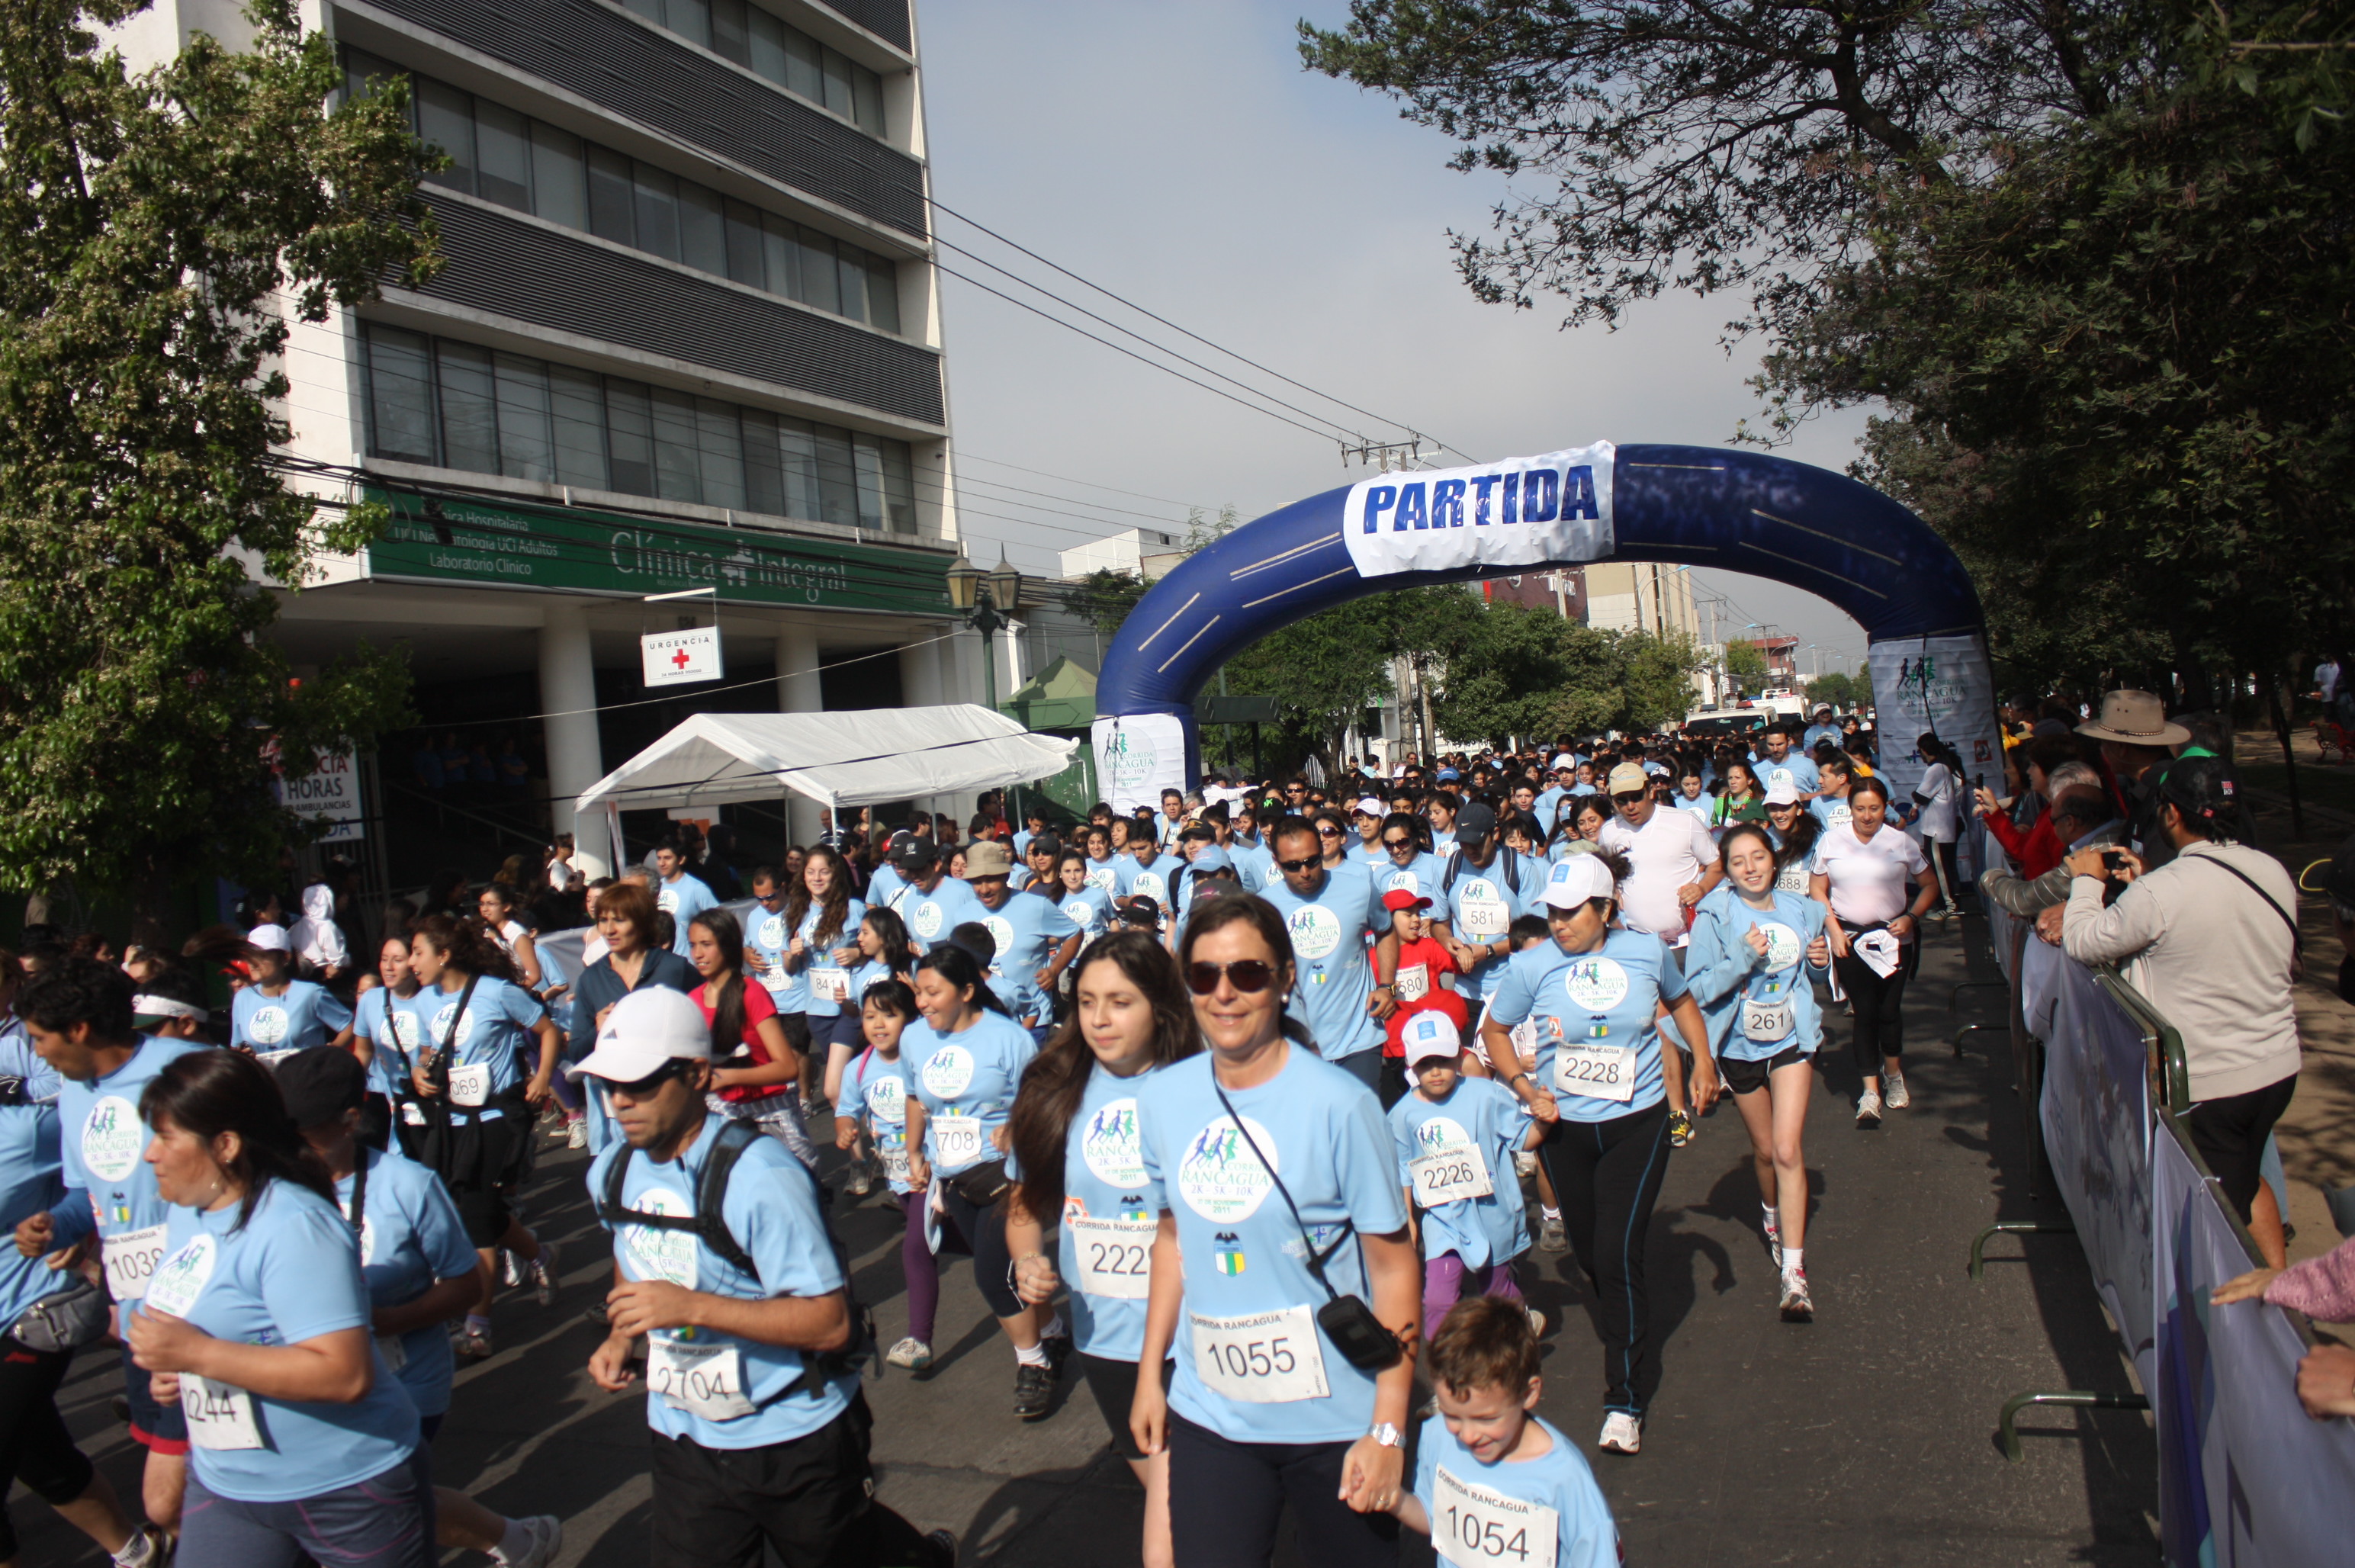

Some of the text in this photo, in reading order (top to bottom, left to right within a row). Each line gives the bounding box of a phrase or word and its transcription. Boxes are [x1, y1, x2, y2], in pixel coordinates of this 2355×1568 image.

[1364, 464, 1599, 534] PARTIDA
[497, 537, 516, 551] UCI
[519, 537, 557, 556] Adultos
[430, 553, 493, 571] Laboratorio
[612, 529, 847, 602] Clínica Integral
[649, 636, 710, 650] URGENCIA
[1897, 686, 1966, 700] RANCAGUA
[1907, 699, 1917, 708] 2K
[1123, 751, 1154, 760] CORRIDA
[287, 777, 343, 800] HORAS
[295, 800, 352, 812] AMBULANCIAS
[1471, 911, 1493, 925] 581
[815, 977, 835, 991] 841
[1569, 981, 1626, 992] RANCAGUA
[1746, 1001, 1768, 1009] CORRIDA
[1751, 1007, 1793, 1030] 2611
[1564, 1057, 1620, 1084] 2228
[109, 1129, 139, 1139] CORRIDA
[83, 1138, 140, 1154] RANCAGUA
[90, 1153, 101, 1162] 2K
[118, 1151, 131, 1159] 10K
[1098, 1157, 1112, 1166] 2K
[1120, 1157, 1132, 1165] 5K
[1409, 1155, 1435, 1168] CORRIDA
[1435, 1149, 1465, 1160] RANCAGUA
[1120, 1173, 1137, 1181] 2011
[1182, 1170, 1269, 1187] RANCAGUA
[1424, 1162, 1474, 1190] 2226
[1190, 1184, 1203, 1194] 2K
[1214, 1185, 1226, 1195] 5K
[1236, 1186, 1255, 1196] 10K
[1075, 1221, 1111, 1231] CORRIDA
[120, 1231, 157, 1244] RANCAGUA
[1091, 1242, 1154, 1276] 222
[1224, 1314, 1282, 1331] RANCAGUA
[652, 1342, 723, 1358] CORRIDA RANCAGUA
[1208, 1337, 1296, 1377] 1055
[658, 1367, 730, 1401] 2704
[1438, 1470, 1529, 1515] CORRIDA RANCAGUA
[1447, 1505, 1530, 1562] 1054
